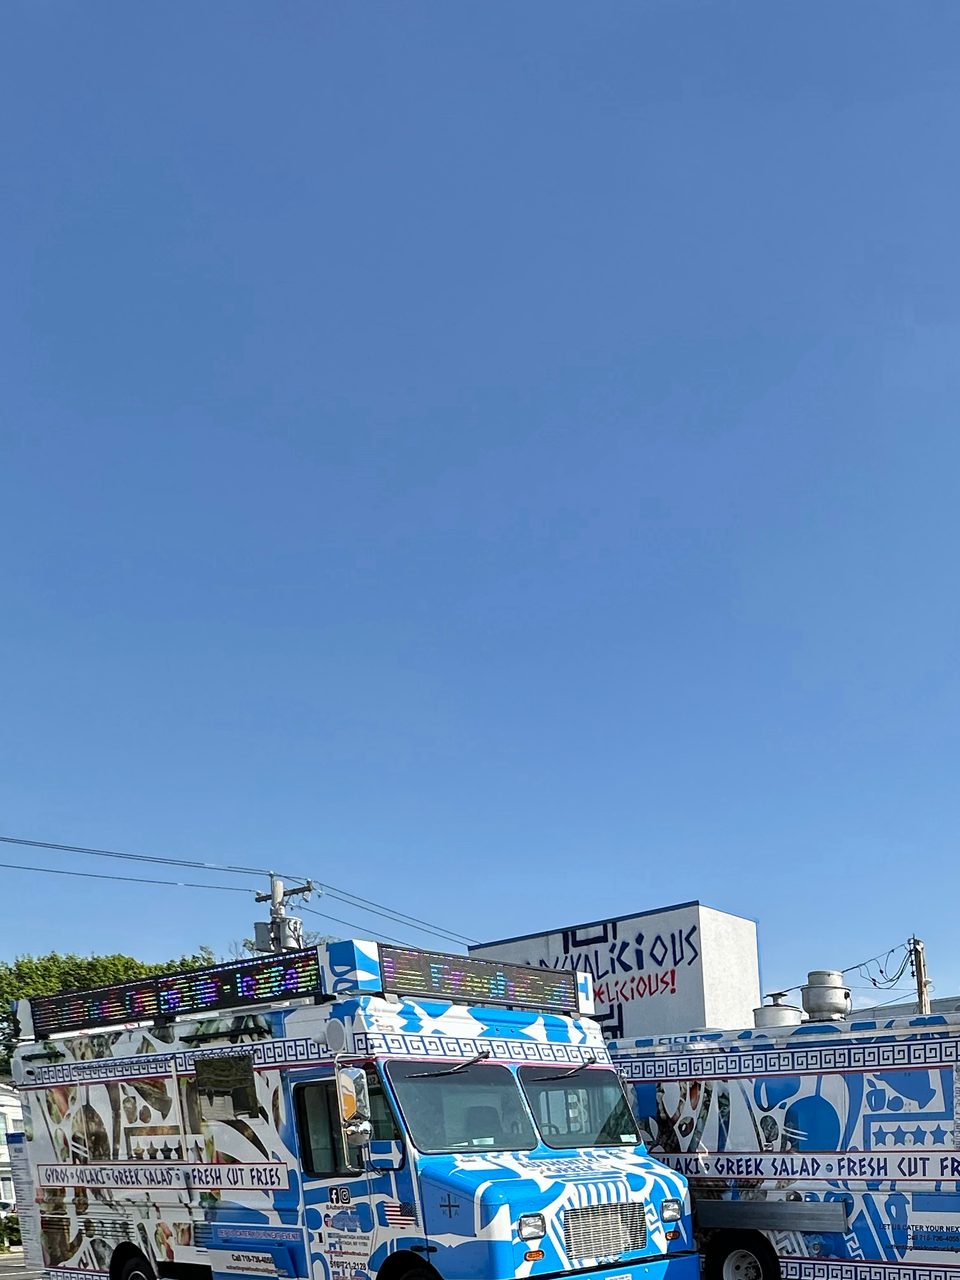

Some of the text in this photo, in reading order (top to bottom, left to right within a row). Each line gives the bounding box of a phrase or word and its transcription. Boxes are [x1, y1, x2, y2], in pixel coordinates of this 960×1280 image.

[714, 1157, 765, 1176] GREEK
[771, 1157, 821, 1177] SALAD
[837, 1156, 889, 1177] FRESH
[897, 1156, 930, 1177] CUT
[44, 1168, 70, 1183] GYROS
[112, 1168, 142, 1186] GREEK
[143, 1168, 173, 1186] SALAD
[191, 1167, 223, 1186] FRESH
[226, 1167, 245, 1186] CUT
[250, 1167, 281, 1187] FRIES
[902, 1224, 924, 1232] CATER
